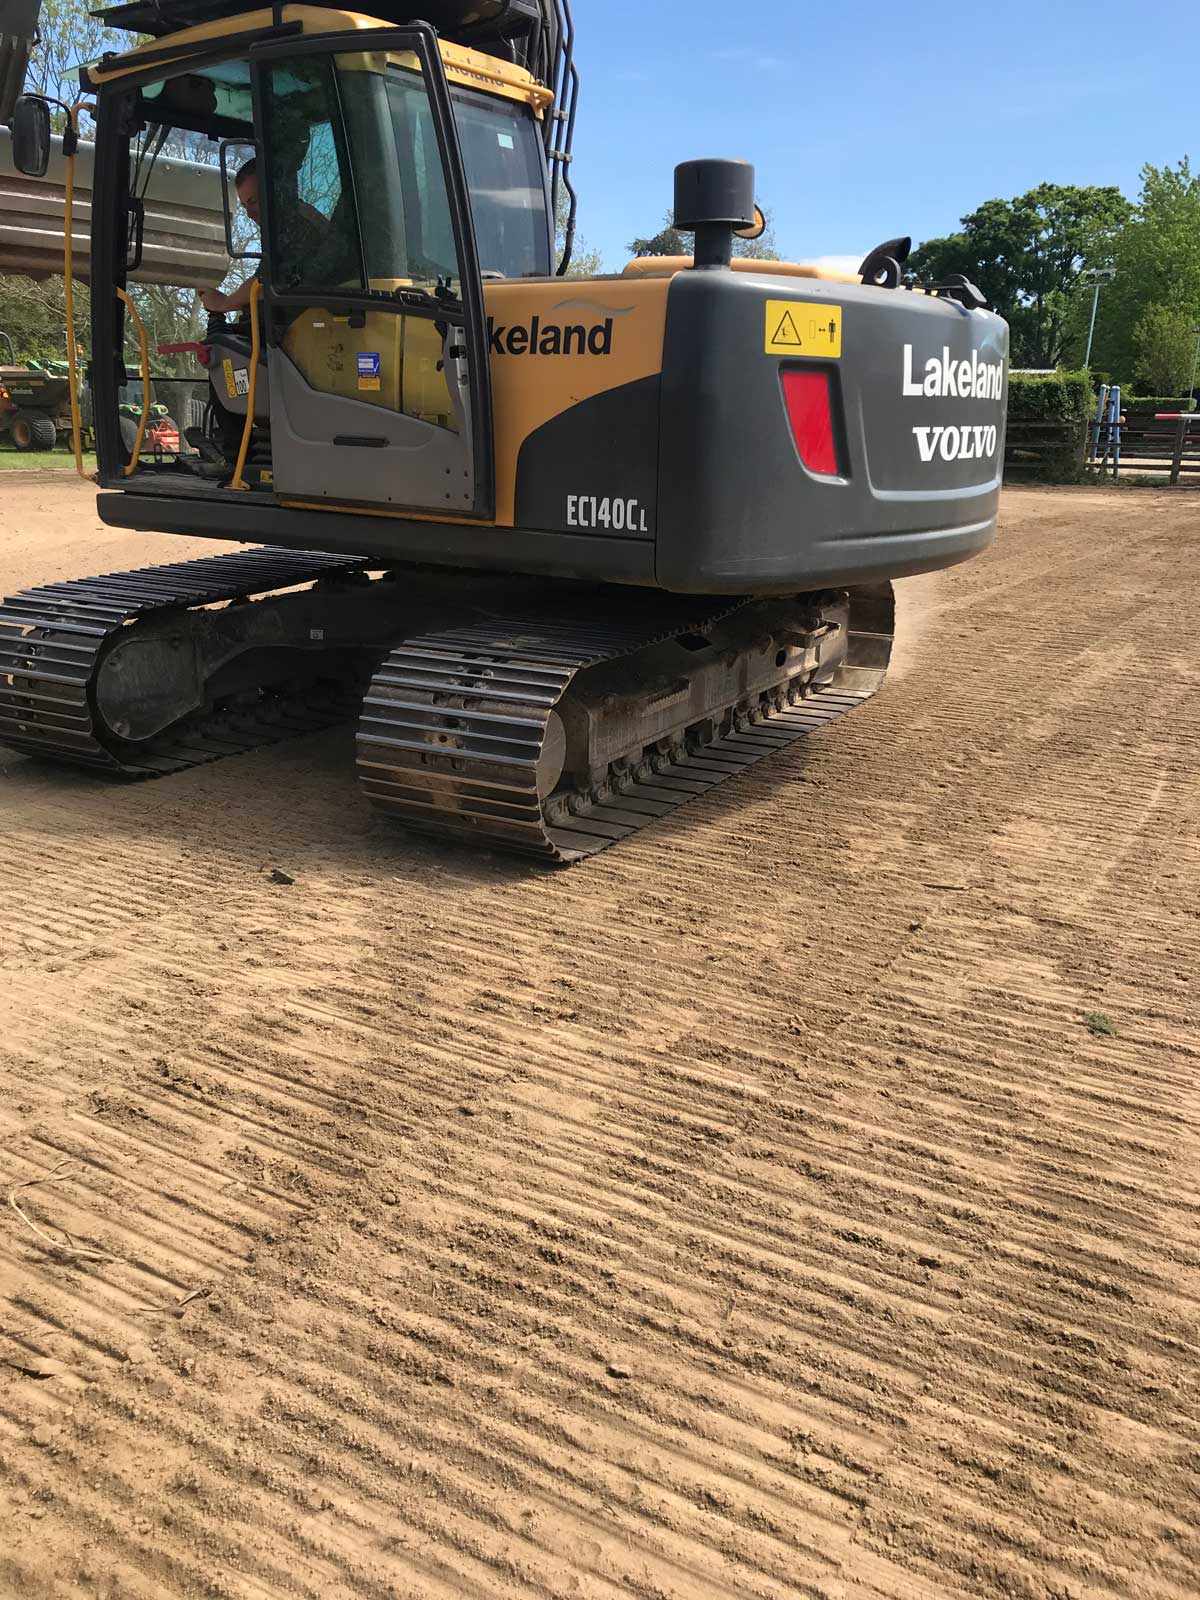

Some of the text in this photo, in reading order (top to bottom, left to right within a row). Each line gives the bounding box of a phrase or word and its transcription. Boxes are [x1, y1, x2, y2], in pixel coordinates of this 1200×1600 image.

[486, 316, 613, 355] keland
[902, 344, 1003, 400] Lakeland
[912, 425, 997, 462] VOLVO
